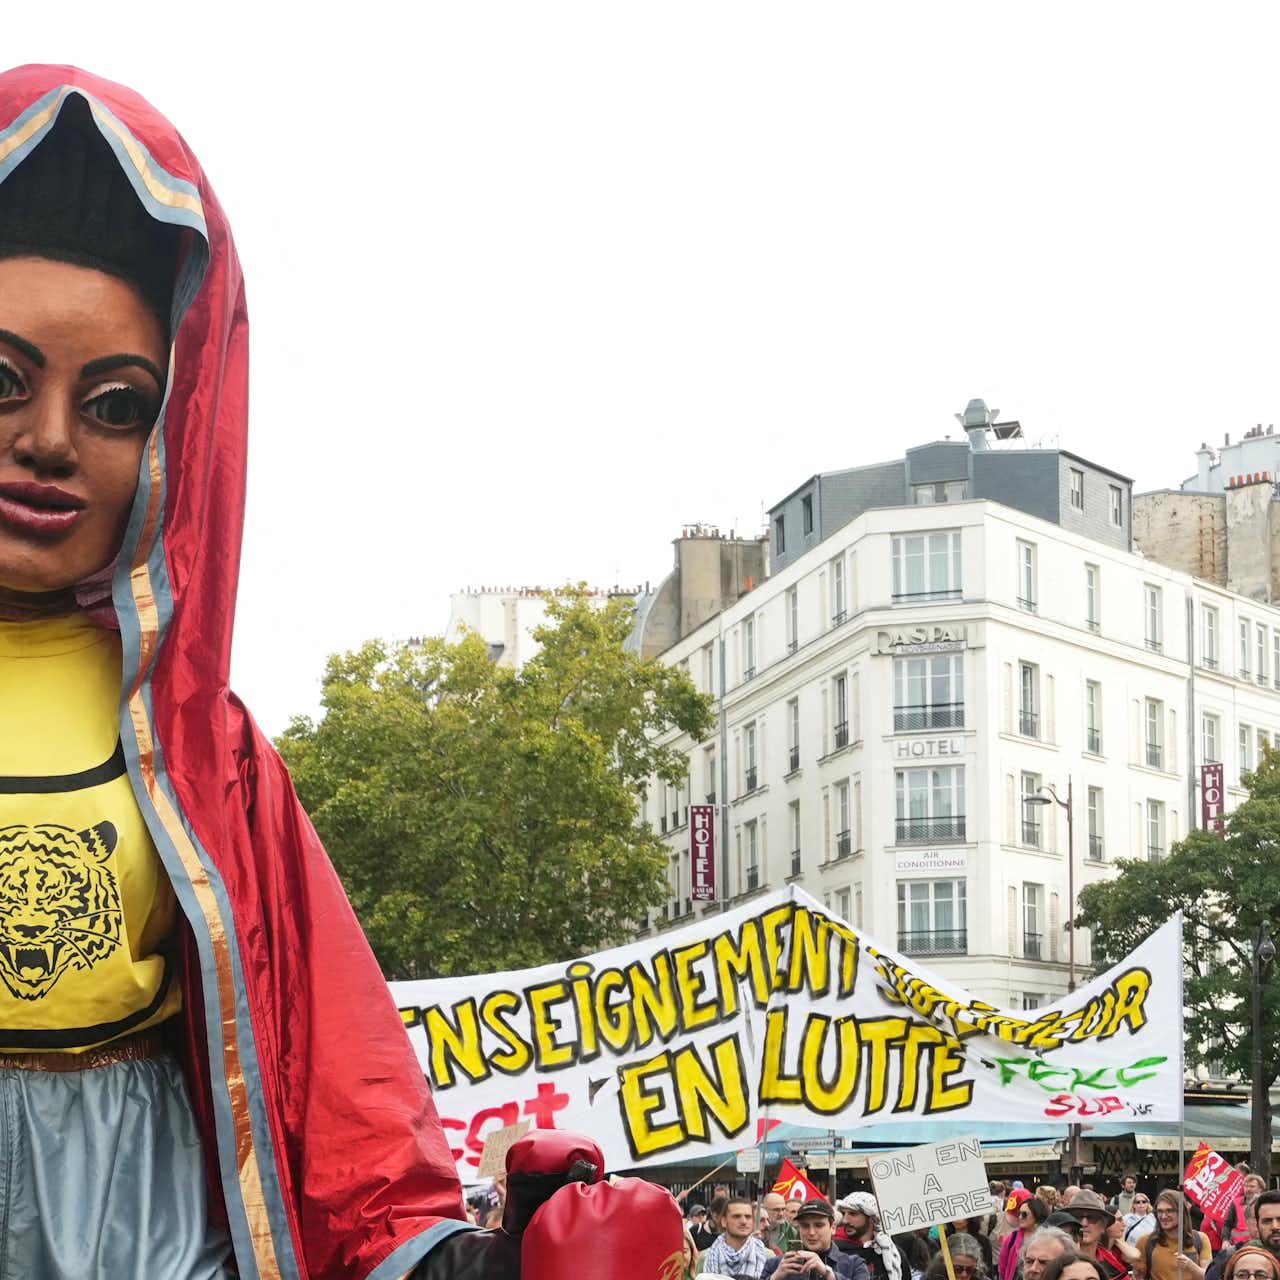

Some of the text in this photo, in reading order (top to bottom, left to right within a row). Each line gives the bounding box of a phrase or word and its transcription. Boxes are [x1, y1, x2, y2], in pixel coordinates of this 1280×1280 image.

[897, 739, 960, 757] HOTEL
[1205, 772, 1220, 834] HOTE
[694, 814, 710, 887] HOTEL
[617, 1032, 750, 1162] EN
[758, 1004, 976, 1118] LUTTE
[872, 1138, 982, 1180] ON EN
[923, 1173, 943, 1196] A
[881, 1187, 993, 1231] MARRE
